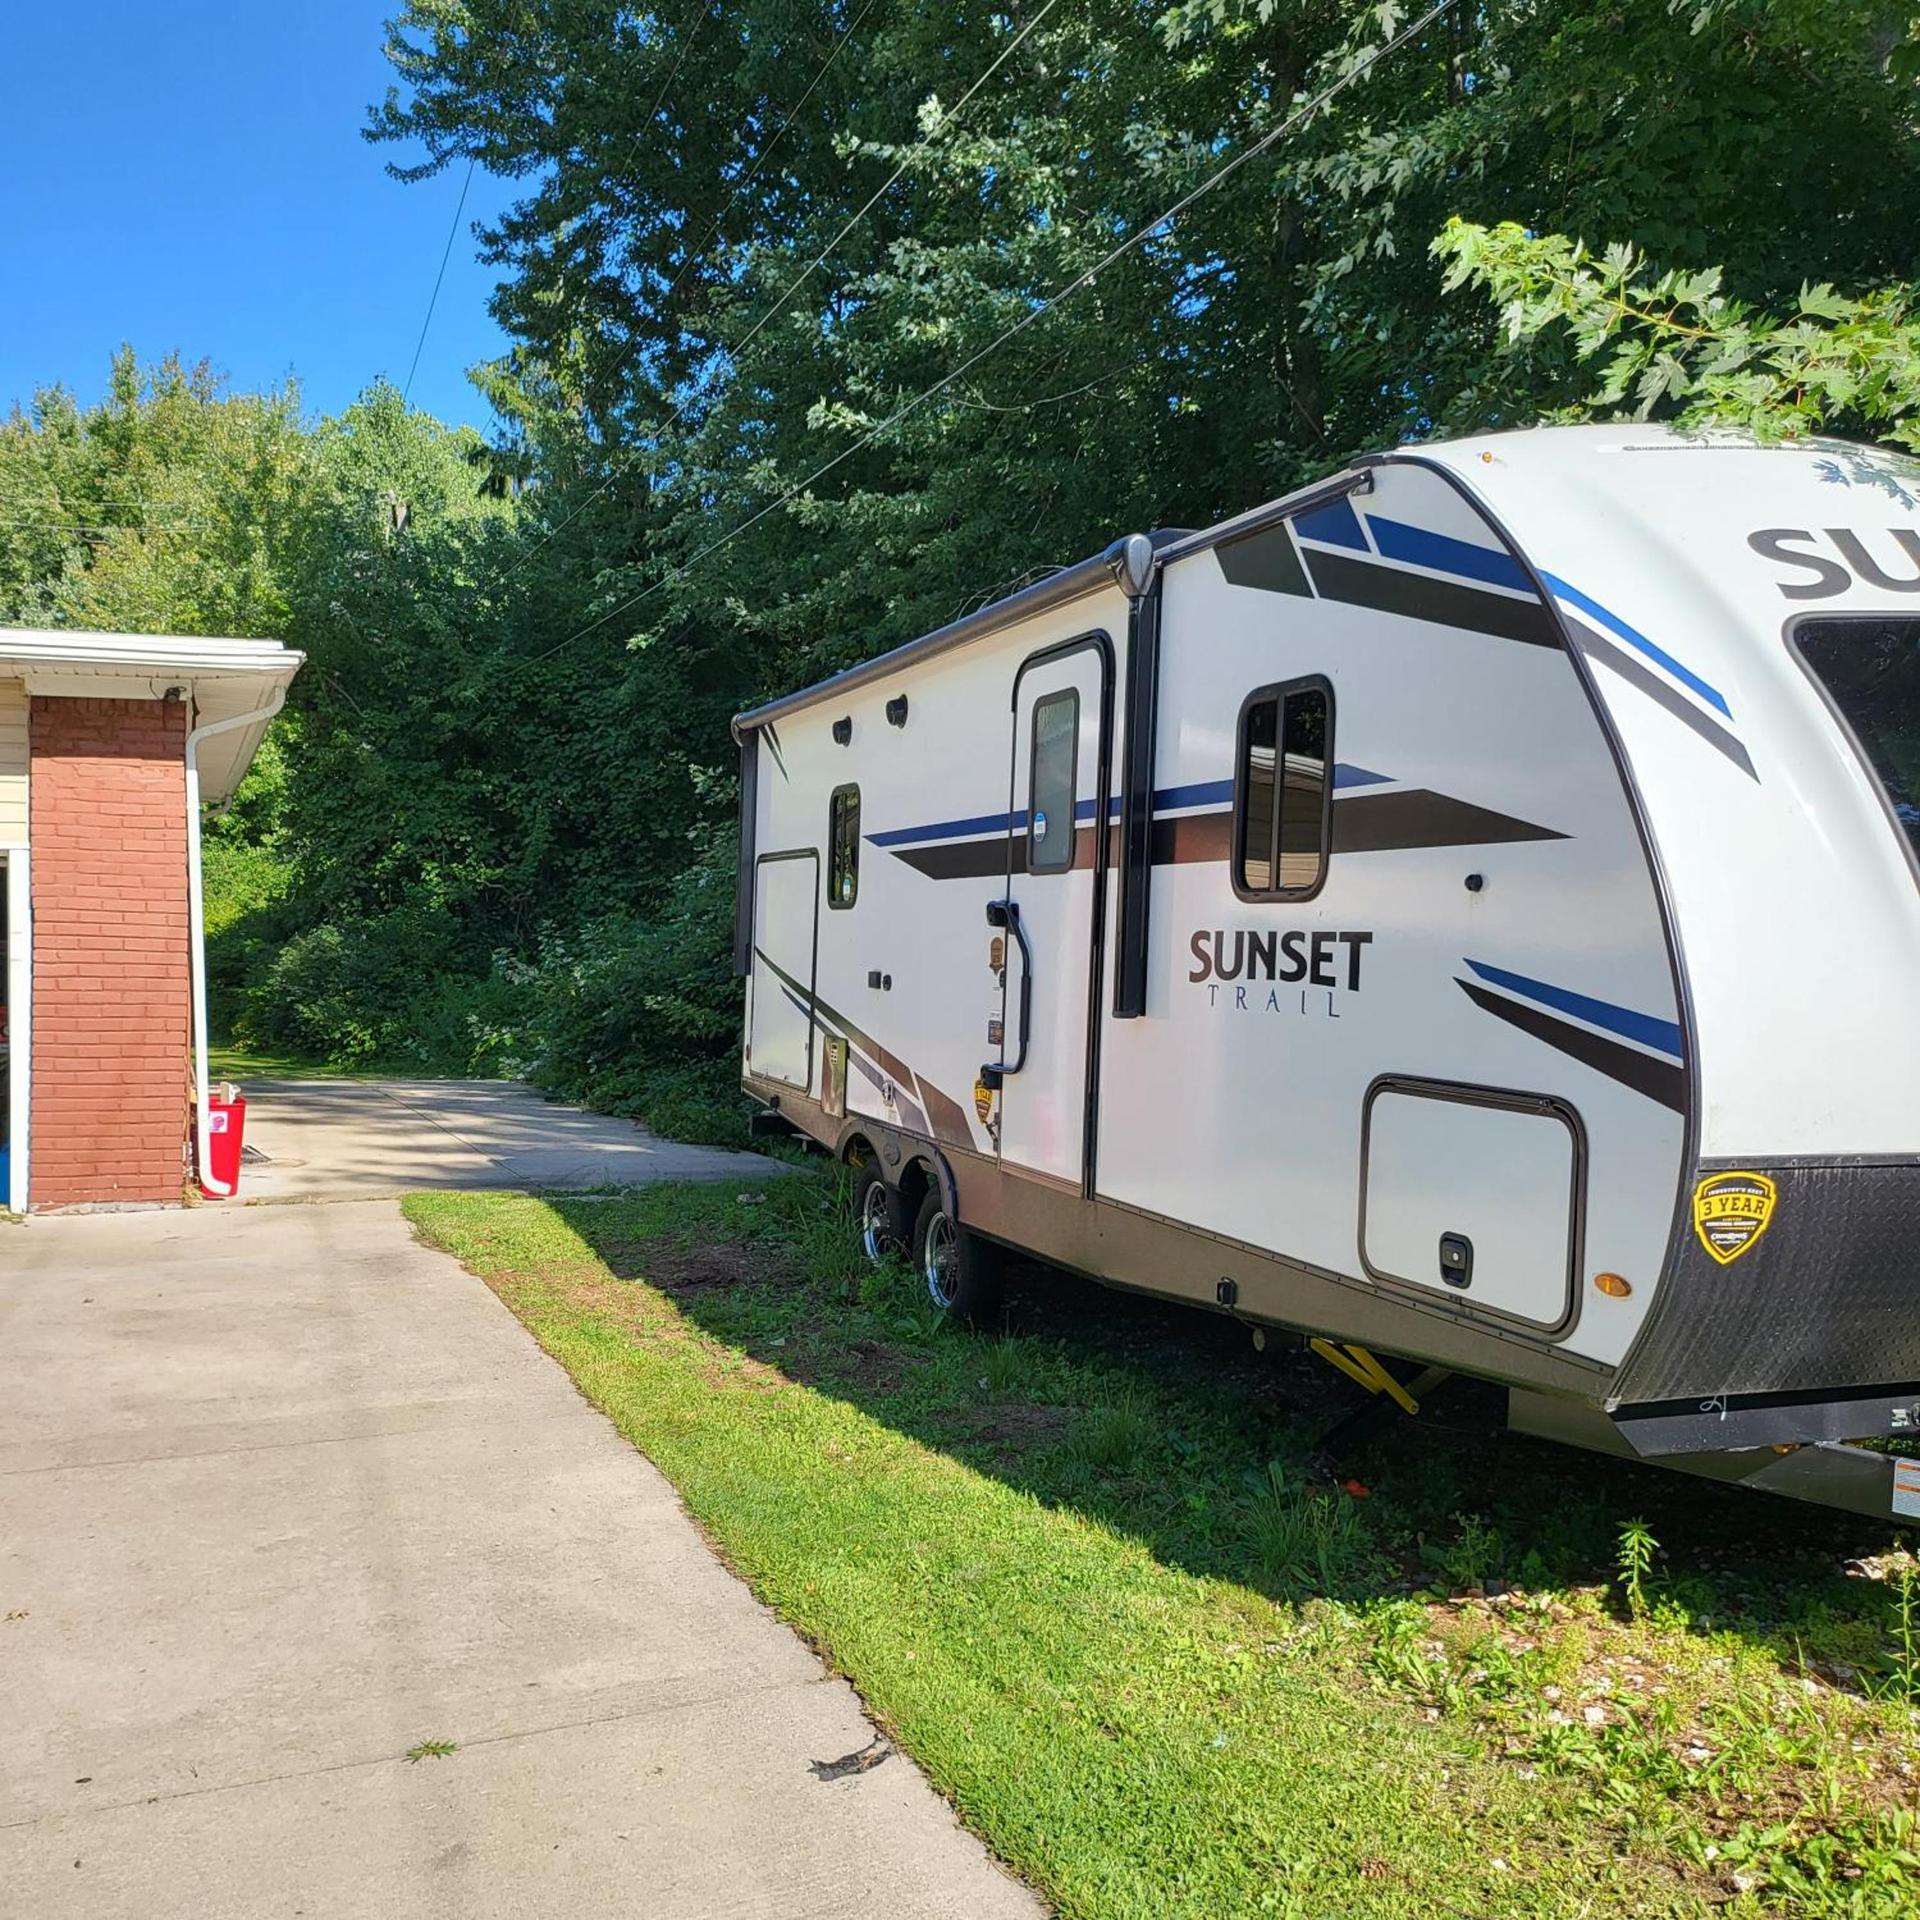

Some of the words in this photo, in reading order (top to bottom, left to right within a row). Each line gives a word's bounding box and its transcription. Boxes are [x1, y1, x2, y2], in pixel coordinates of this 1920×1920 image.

[1189, 930, 1373, 991] SUNSET
[1208, 984, 1341, 1018] TRAIL
[1704, 1202, 1712, 1216] 3
[1719, 1197, 1765, 1215] YEAR
